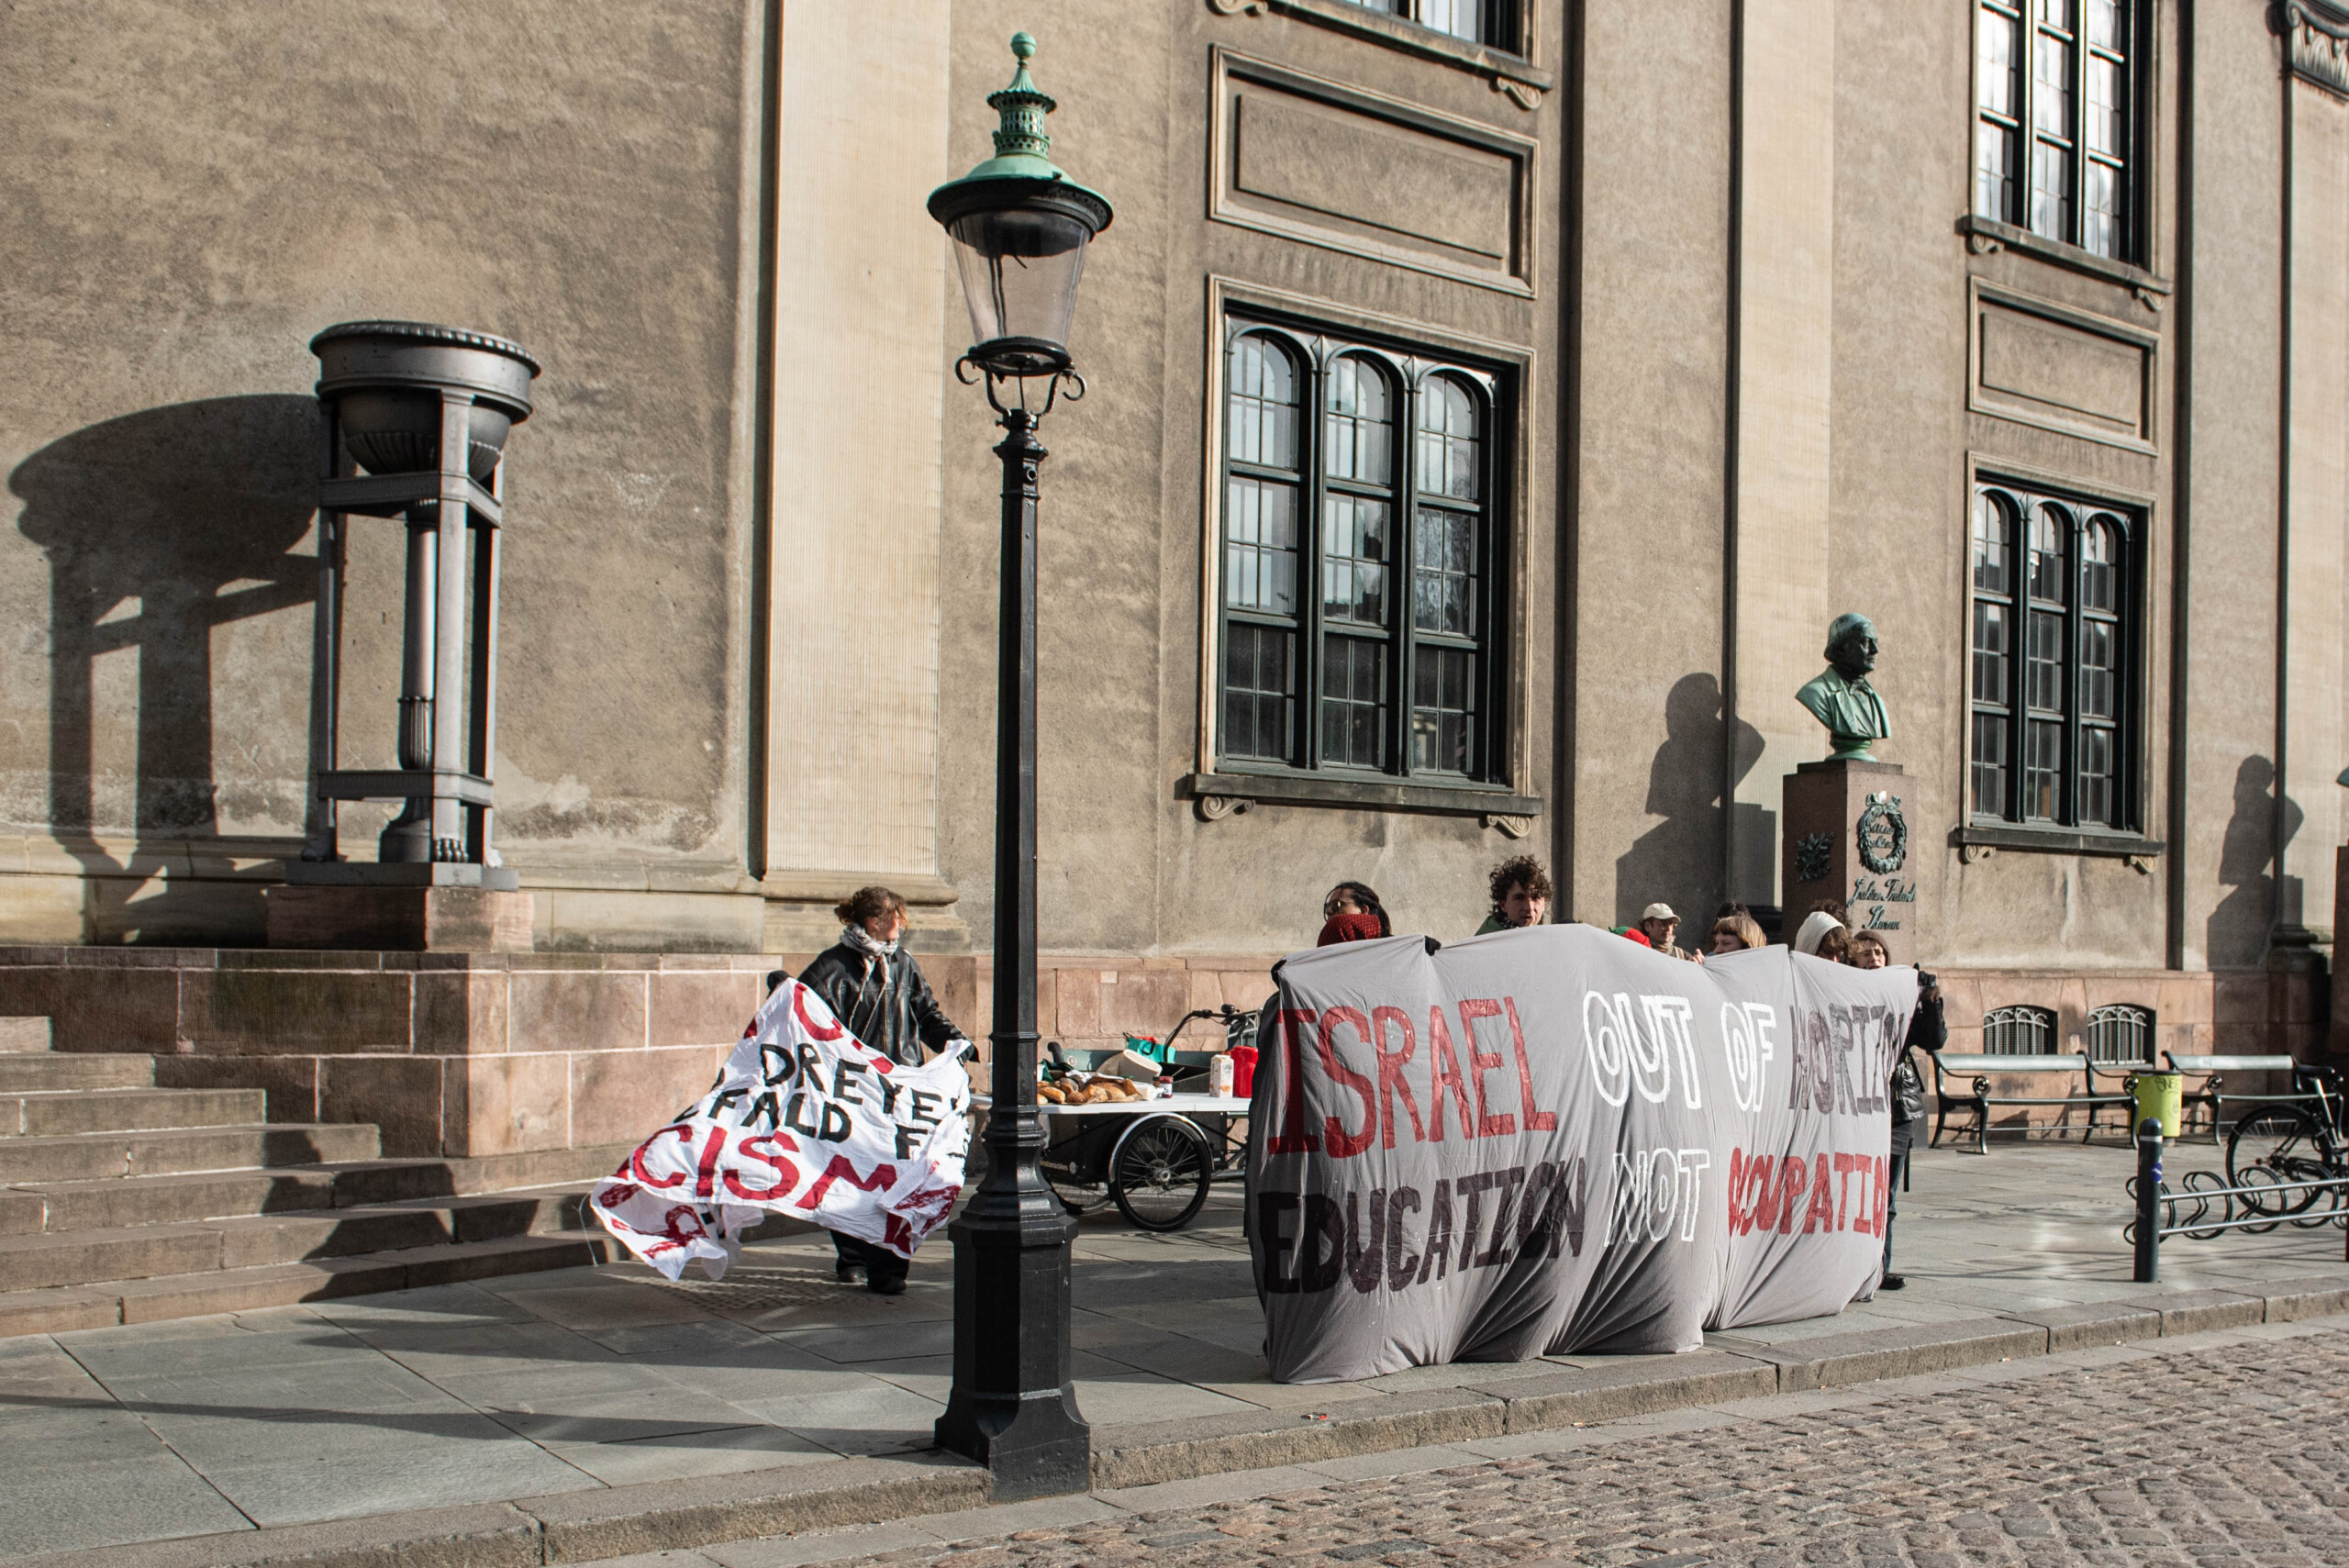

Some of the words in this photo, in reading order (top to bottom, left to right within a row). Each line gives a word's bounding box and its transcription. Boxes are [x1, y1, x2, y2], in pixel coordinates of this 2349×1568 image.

[760, 1043, 961, 1127] DREYE
[1268, 995, 1557, 1158] ISRAEL
[1583, 991, 1701, 1110] OUT
[1720, 1001, 1776, 1113] OF
[1258, 1156, 1586, 1295] EDUCATION
[1604, 1147, 1710, 1248] NOT
[1728, 1147, 1890, 1241] OCCUPATIO
